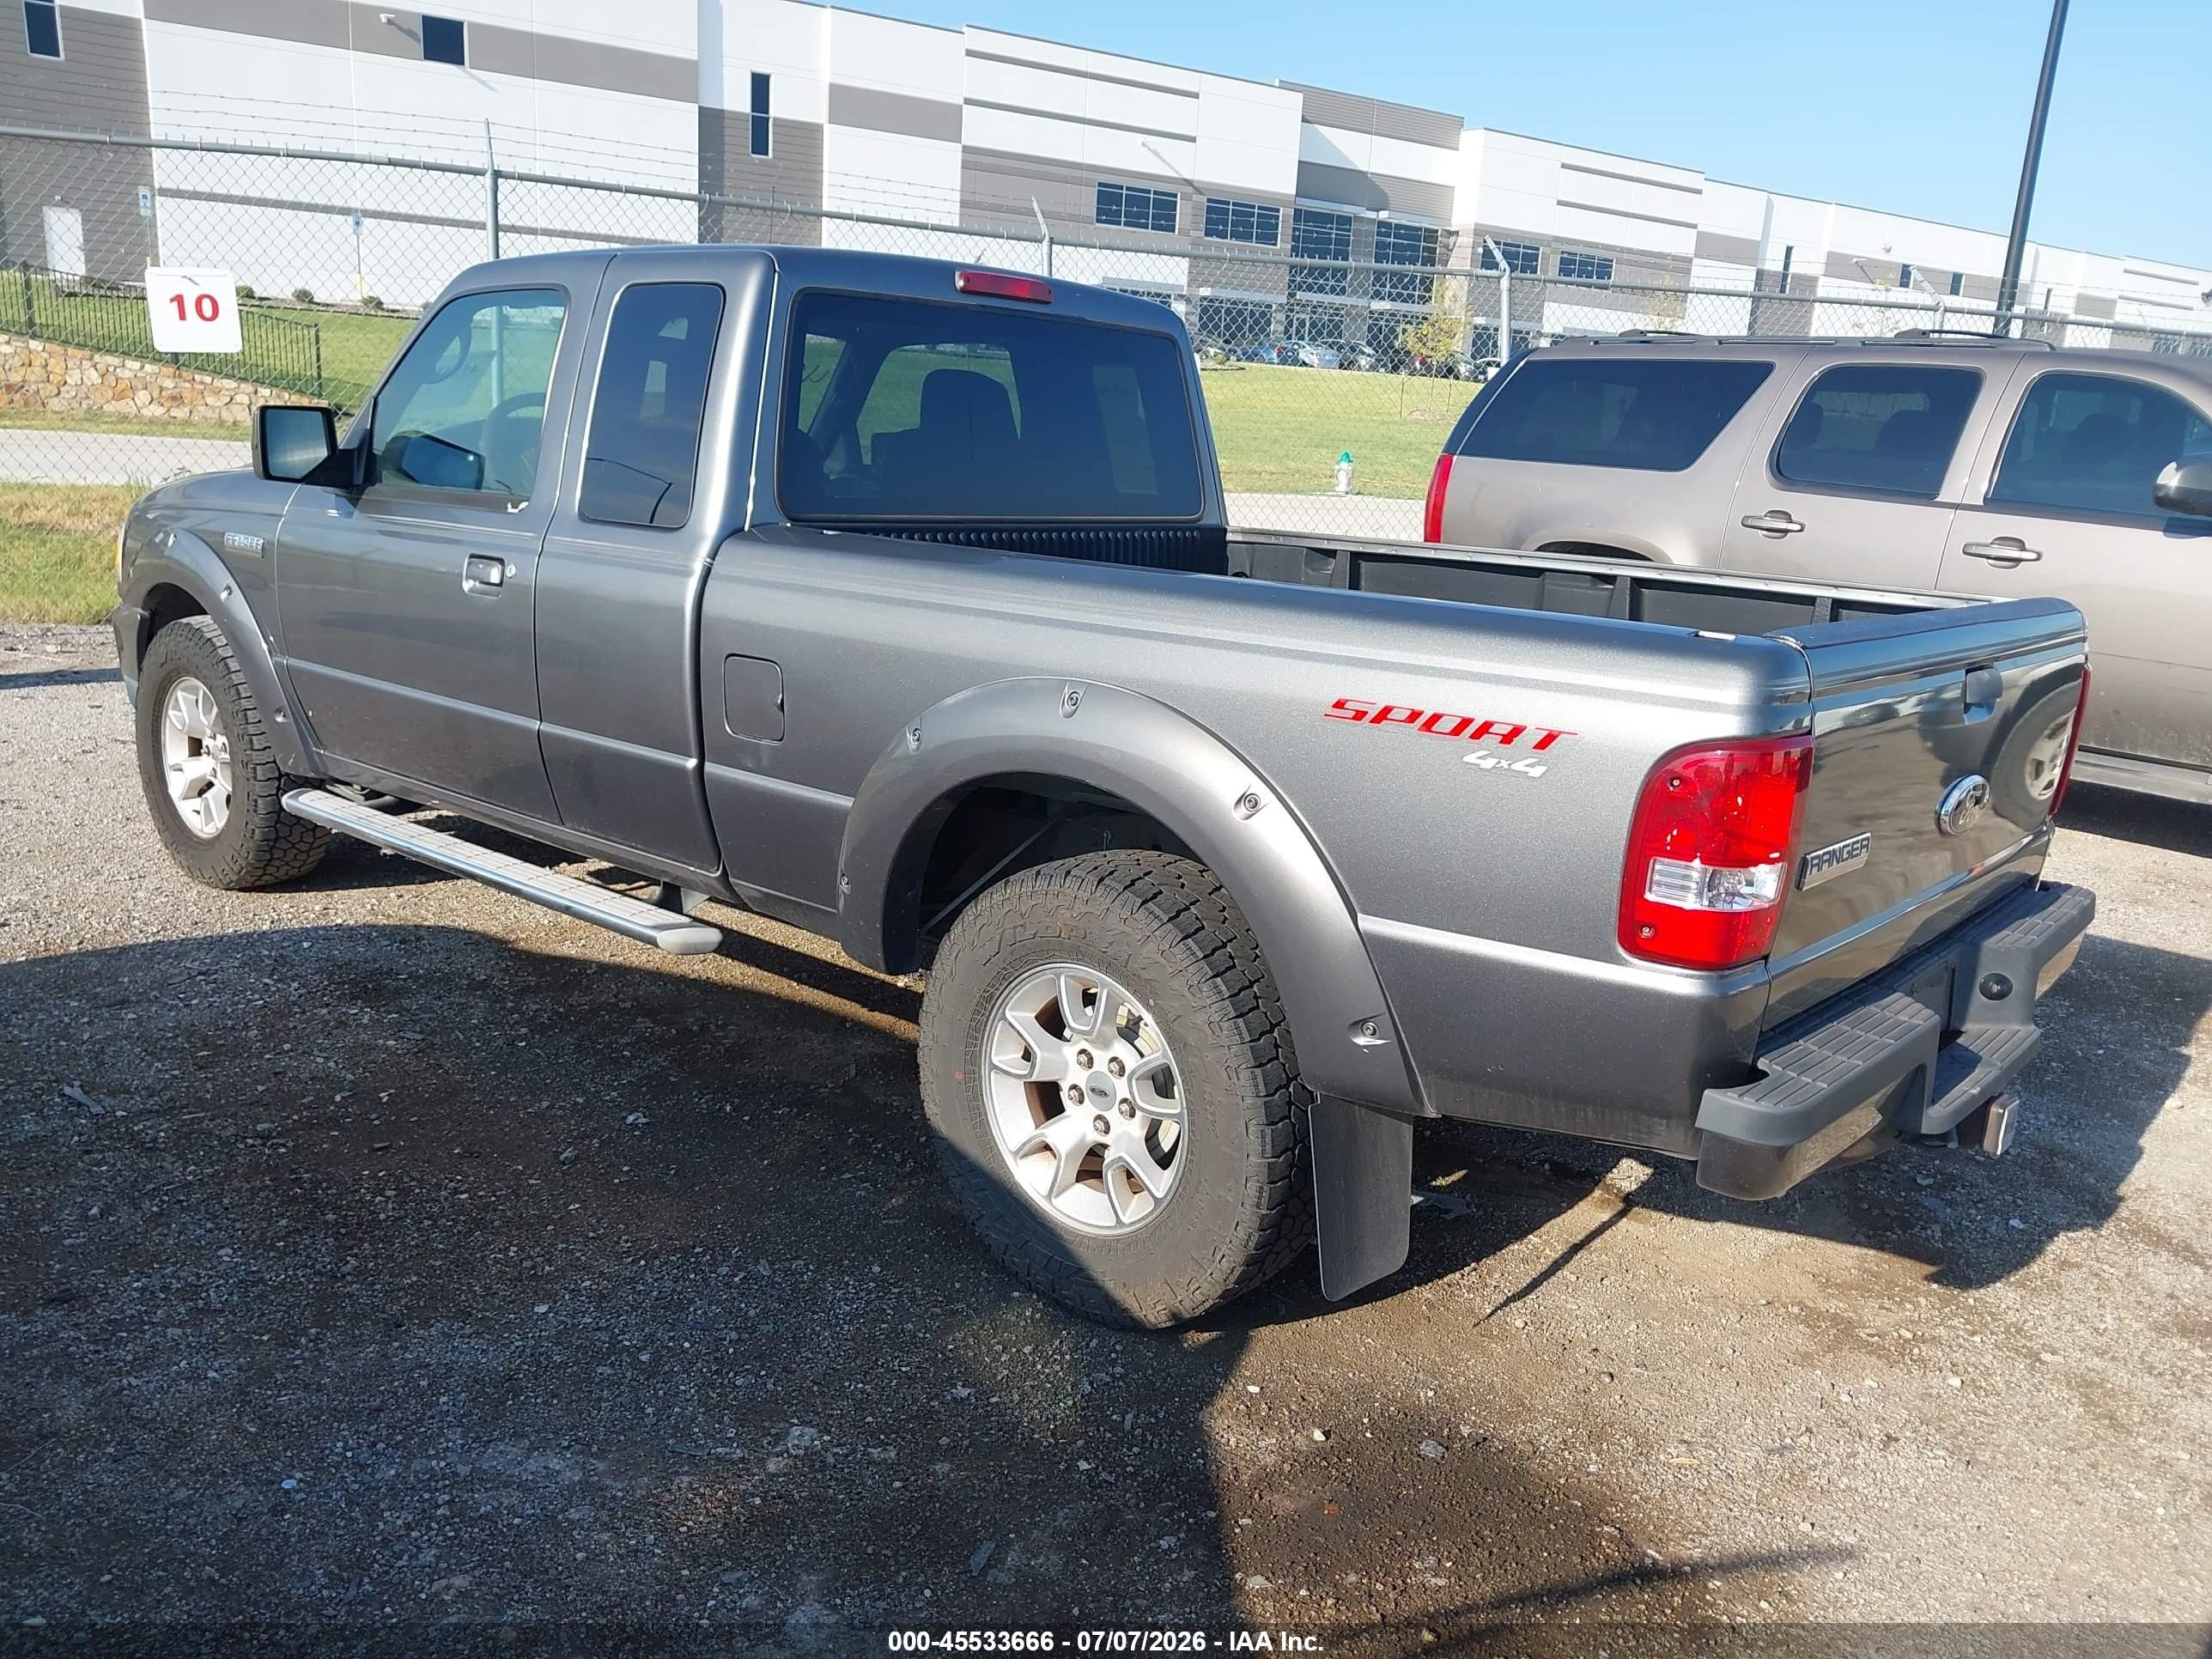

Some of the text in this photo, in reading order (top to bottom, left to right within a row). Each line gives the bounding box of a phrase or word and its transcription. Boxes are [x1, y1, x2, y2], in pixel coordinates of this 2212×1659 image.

[169, 294, 219, 321] 10
[1323, 697, 1578, 751] SPORT
[1808, 836, 1871, 876] RANGER
